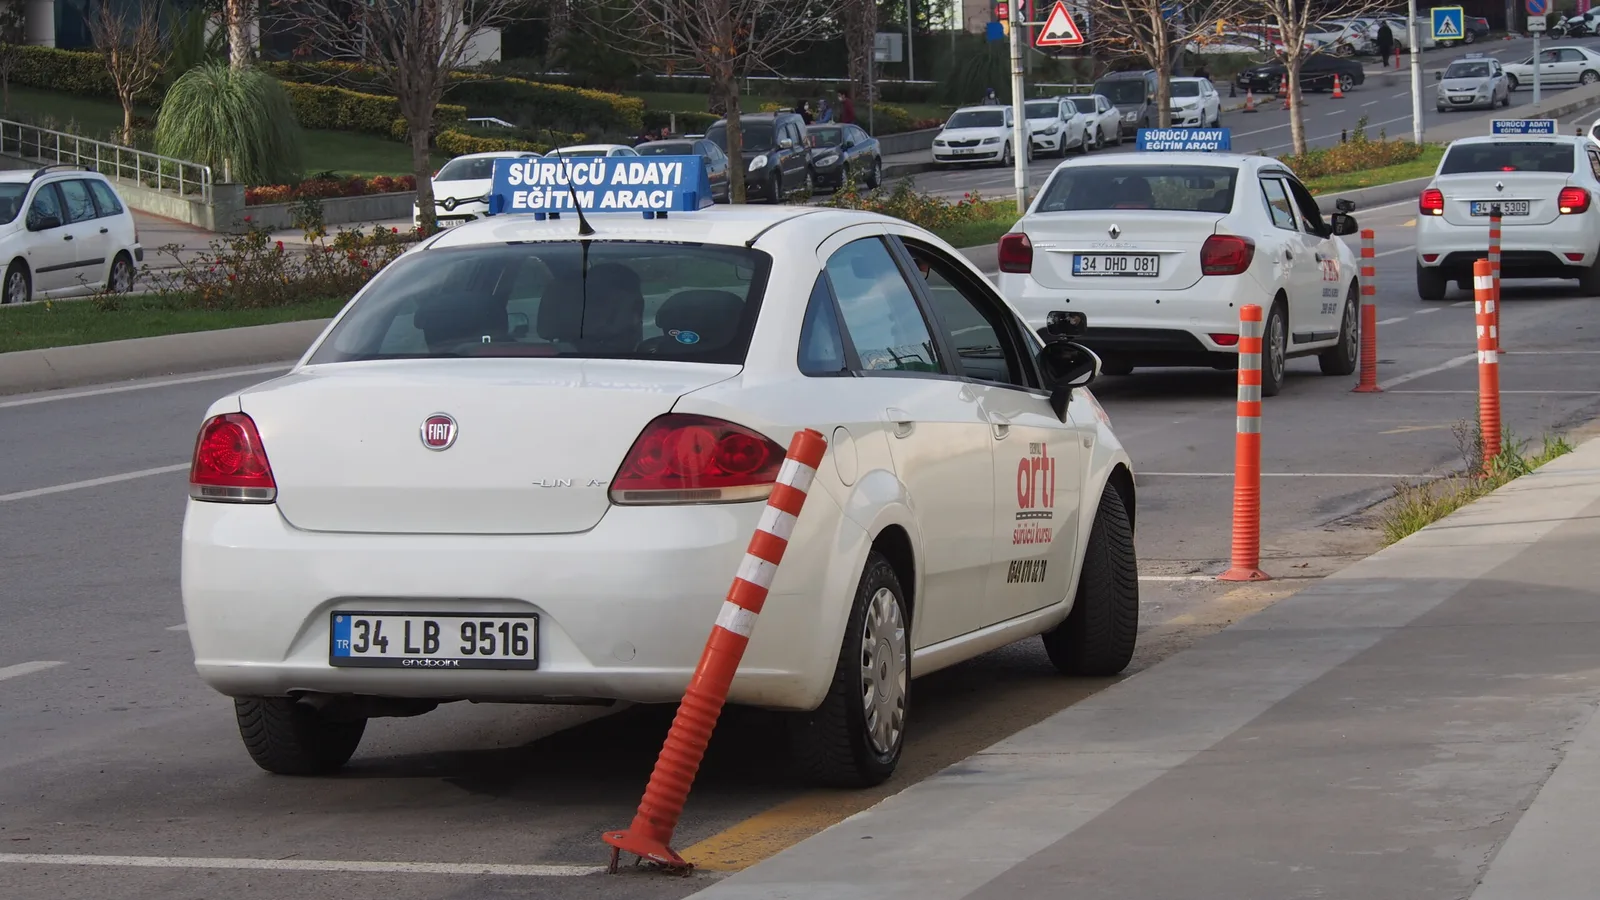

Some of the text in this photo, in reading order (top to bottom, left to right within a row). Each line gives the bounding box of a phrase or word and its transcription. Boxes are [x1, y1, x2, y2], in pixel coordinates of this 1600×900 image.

[1496, 120, 1526, 128] SÜRÜCÜ
[1144, 130, 1222, 141] SÜRÜCÜ ADAYI
[1146, 141, 1218, 150] EĞİTİM ARACI
[507, 158, 683, 186] SÜRÜCÜ ADAYI
[512, 186, 673, 209] EĞİTİM ARACI
[1477, 202, 1487, 212] 34
[1504, 202, 1527, 212] 5309
[1082, 257, 1097, 271] 34
[1105, 257, 1127, 271] DHD
[1134, 257, 1155, 272] 081
[428, 423, 449, 440] FIAT
[1017, 442, 1055, 509] artı
[336, 619, 529, 656] TR 34 LB 9516
[402, 658, 461, 668] endpoint
